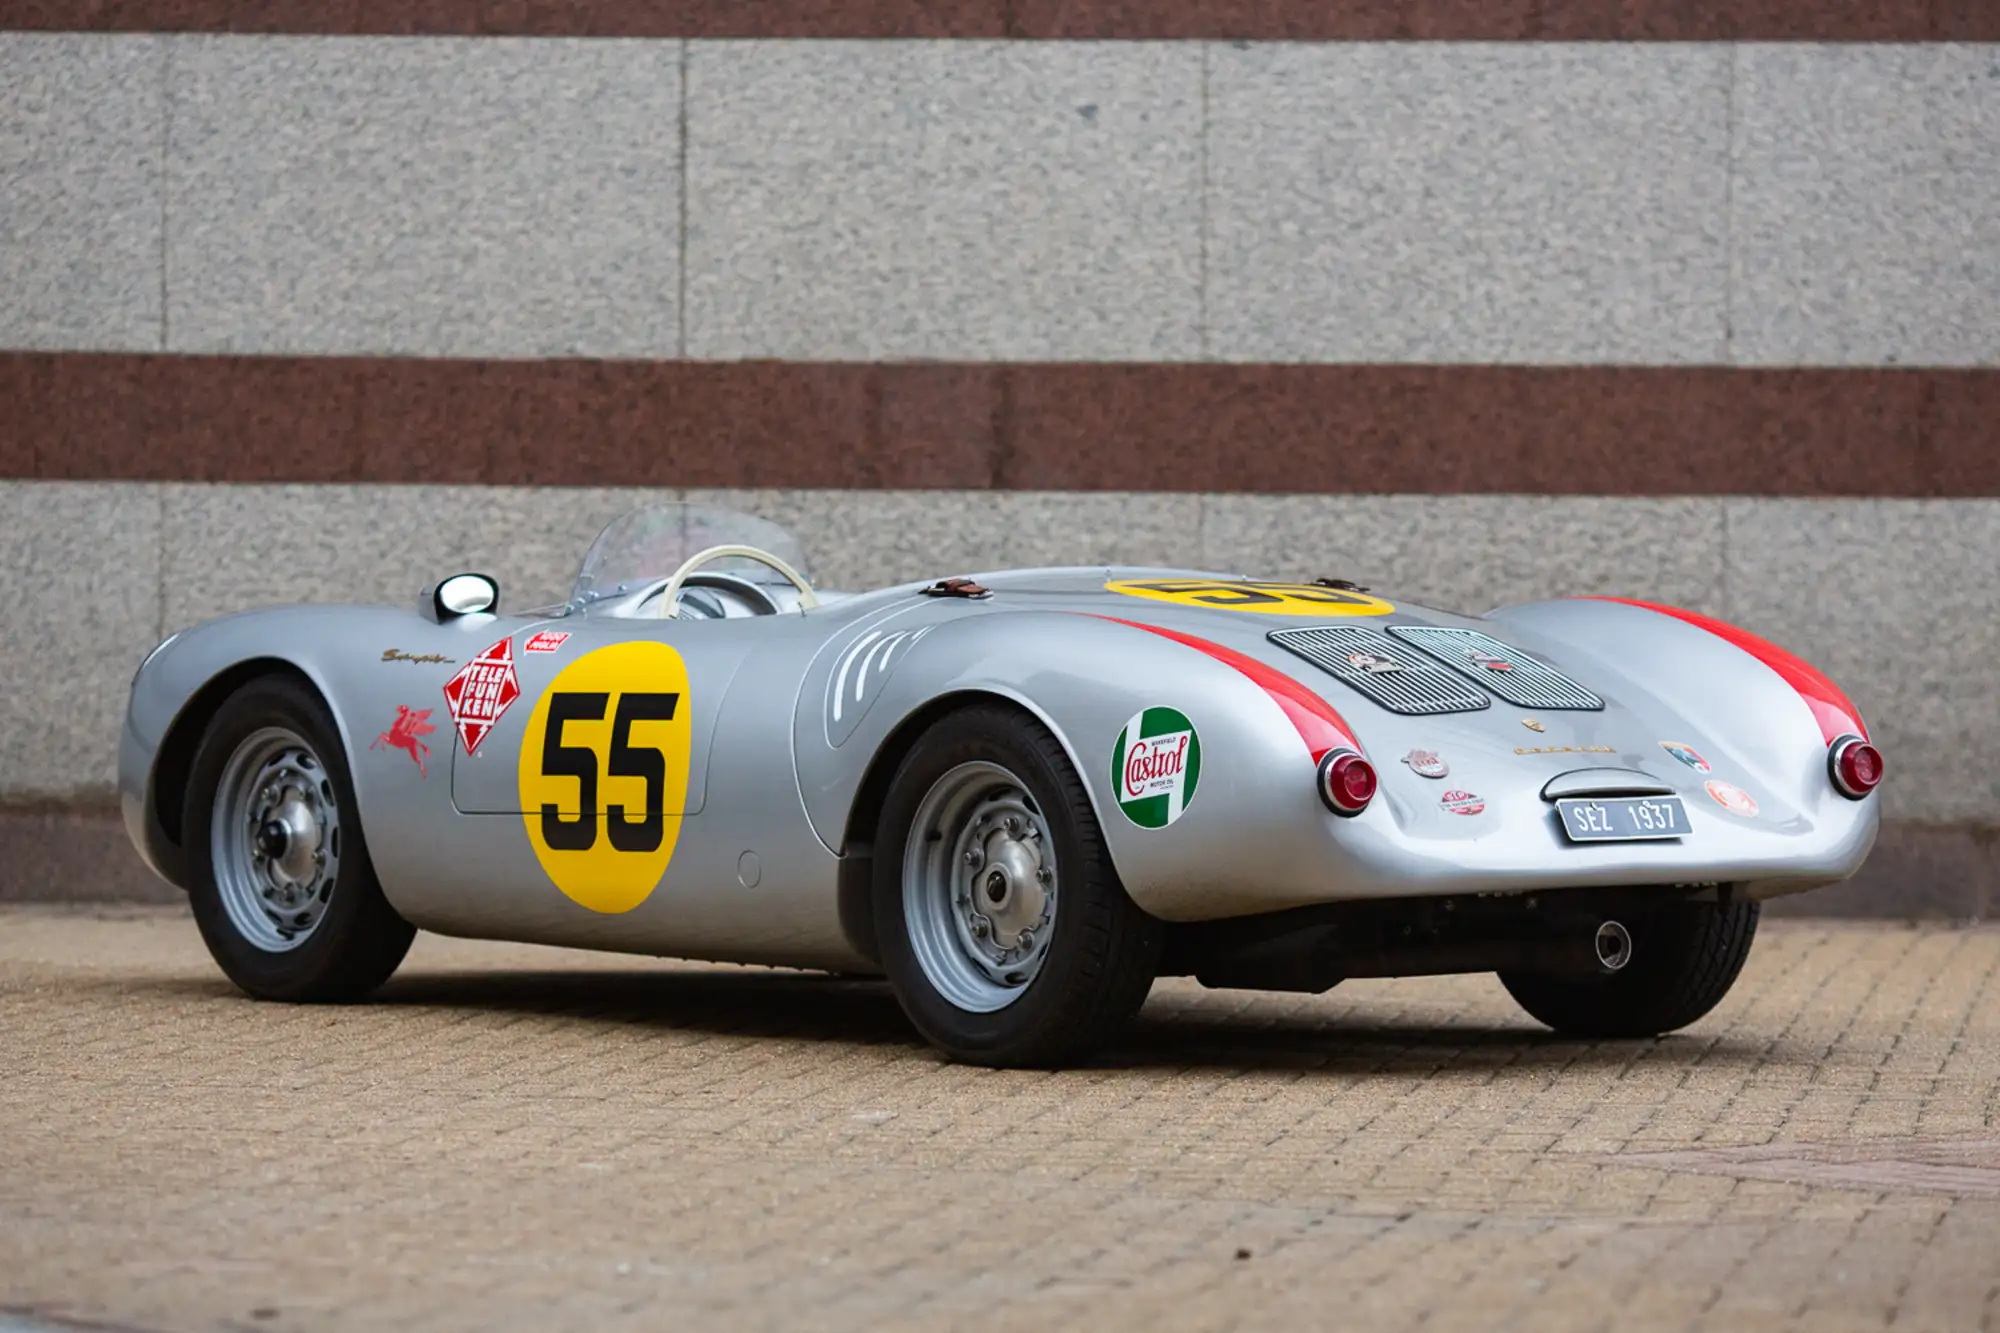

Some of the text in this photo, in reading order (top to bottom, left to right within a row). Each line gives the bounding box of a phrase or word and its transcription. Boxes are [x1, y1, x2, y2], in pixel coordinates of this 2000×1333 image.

[470, 665, 505, 683] TELE
[466, 682, 499, 700] FUN
[462, 698, 494, 716] KEN
[541, 692, 680, 852] 55
[1125, 735, 1188, 796] Castrol
[1573, 804, 1674, 832] SEZ 1937
